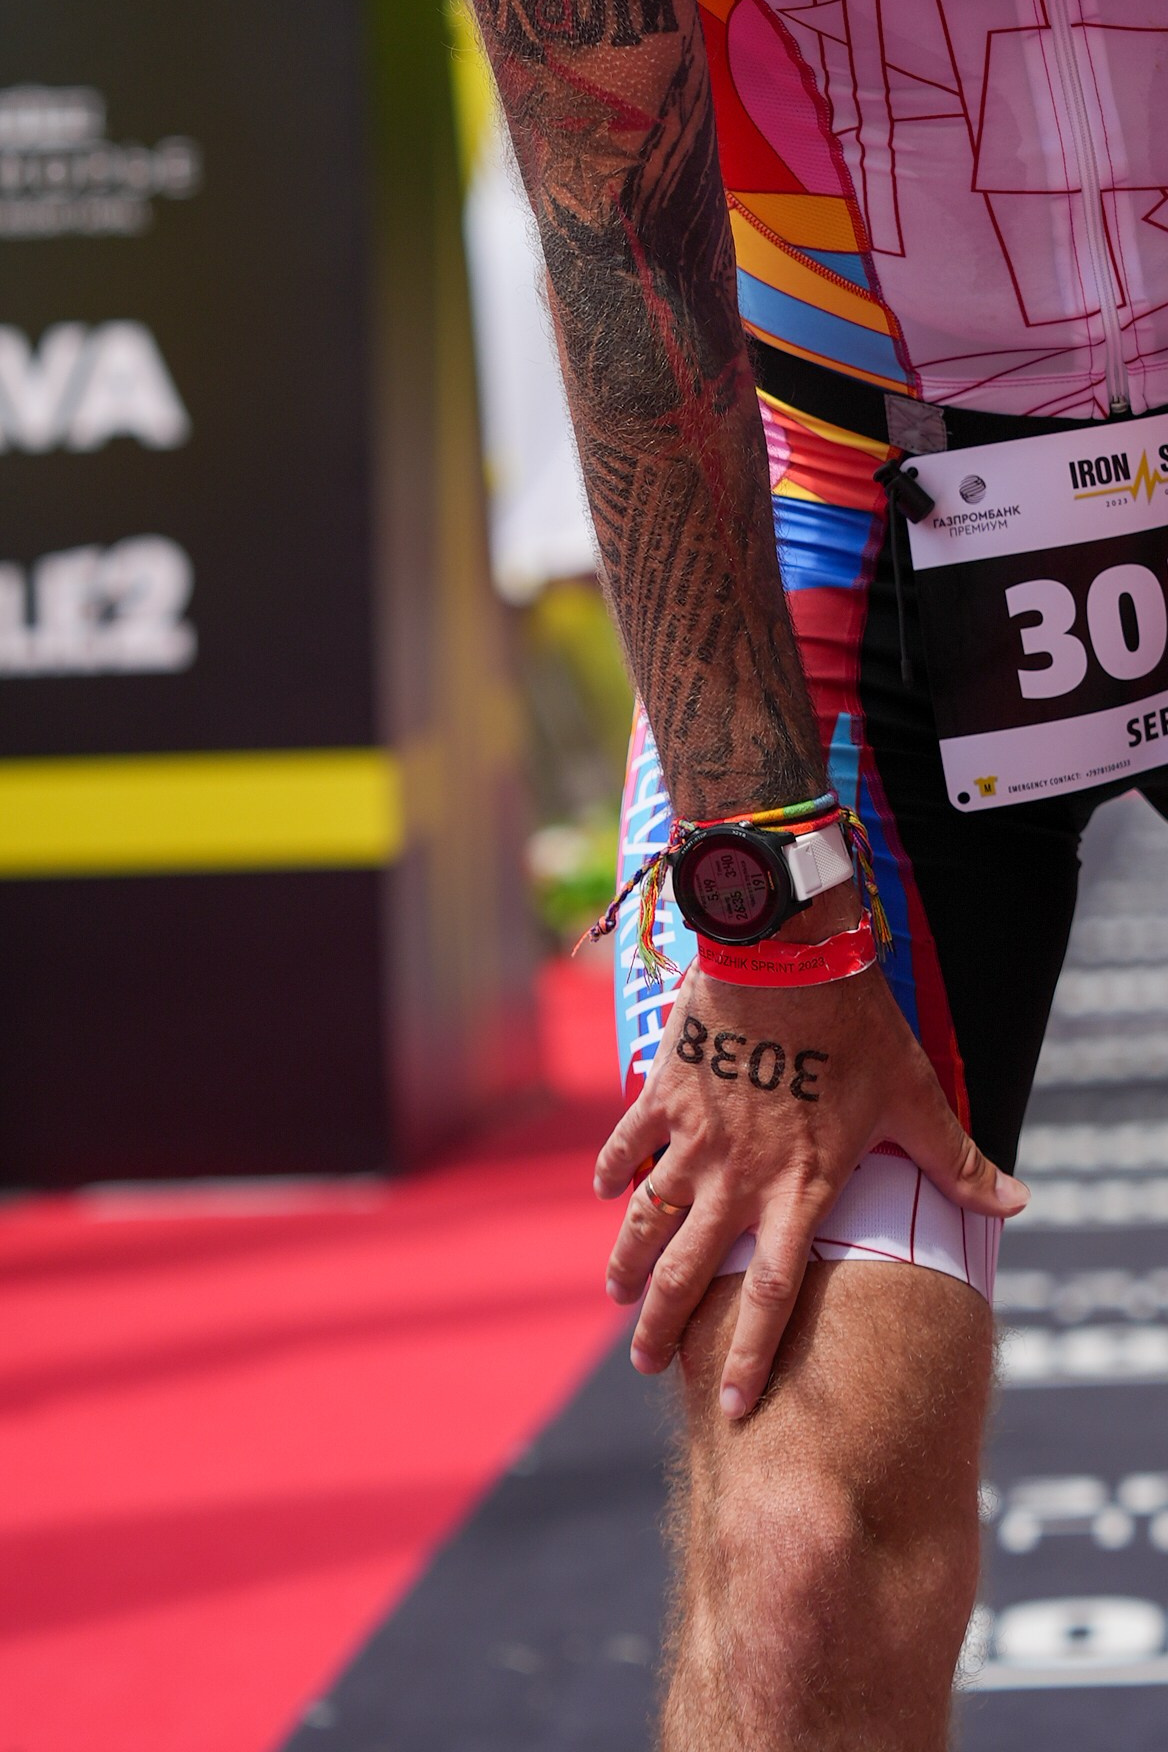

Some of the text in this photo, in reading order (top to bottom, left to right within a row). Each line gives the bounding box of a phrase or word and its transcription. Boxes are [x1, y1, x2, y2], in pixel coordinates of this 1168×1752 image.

[1069, 453, 1131, 489] IRON
[1105, 498, 1129, 508] 2023
[933, 505, 1021, 528] ГАЗПРОМБАНК
[949, 519, 1008, 538] ПРЕМИУМ
[1008, 779, 1048, 794] EMERGENCY
[1049, 772, 1082, 786] CONTACT:
[750, 959, 795, 974] SPRINT
[798, 956, 826, 973] 2023
[676, 1014, 830, 1102] 3038
